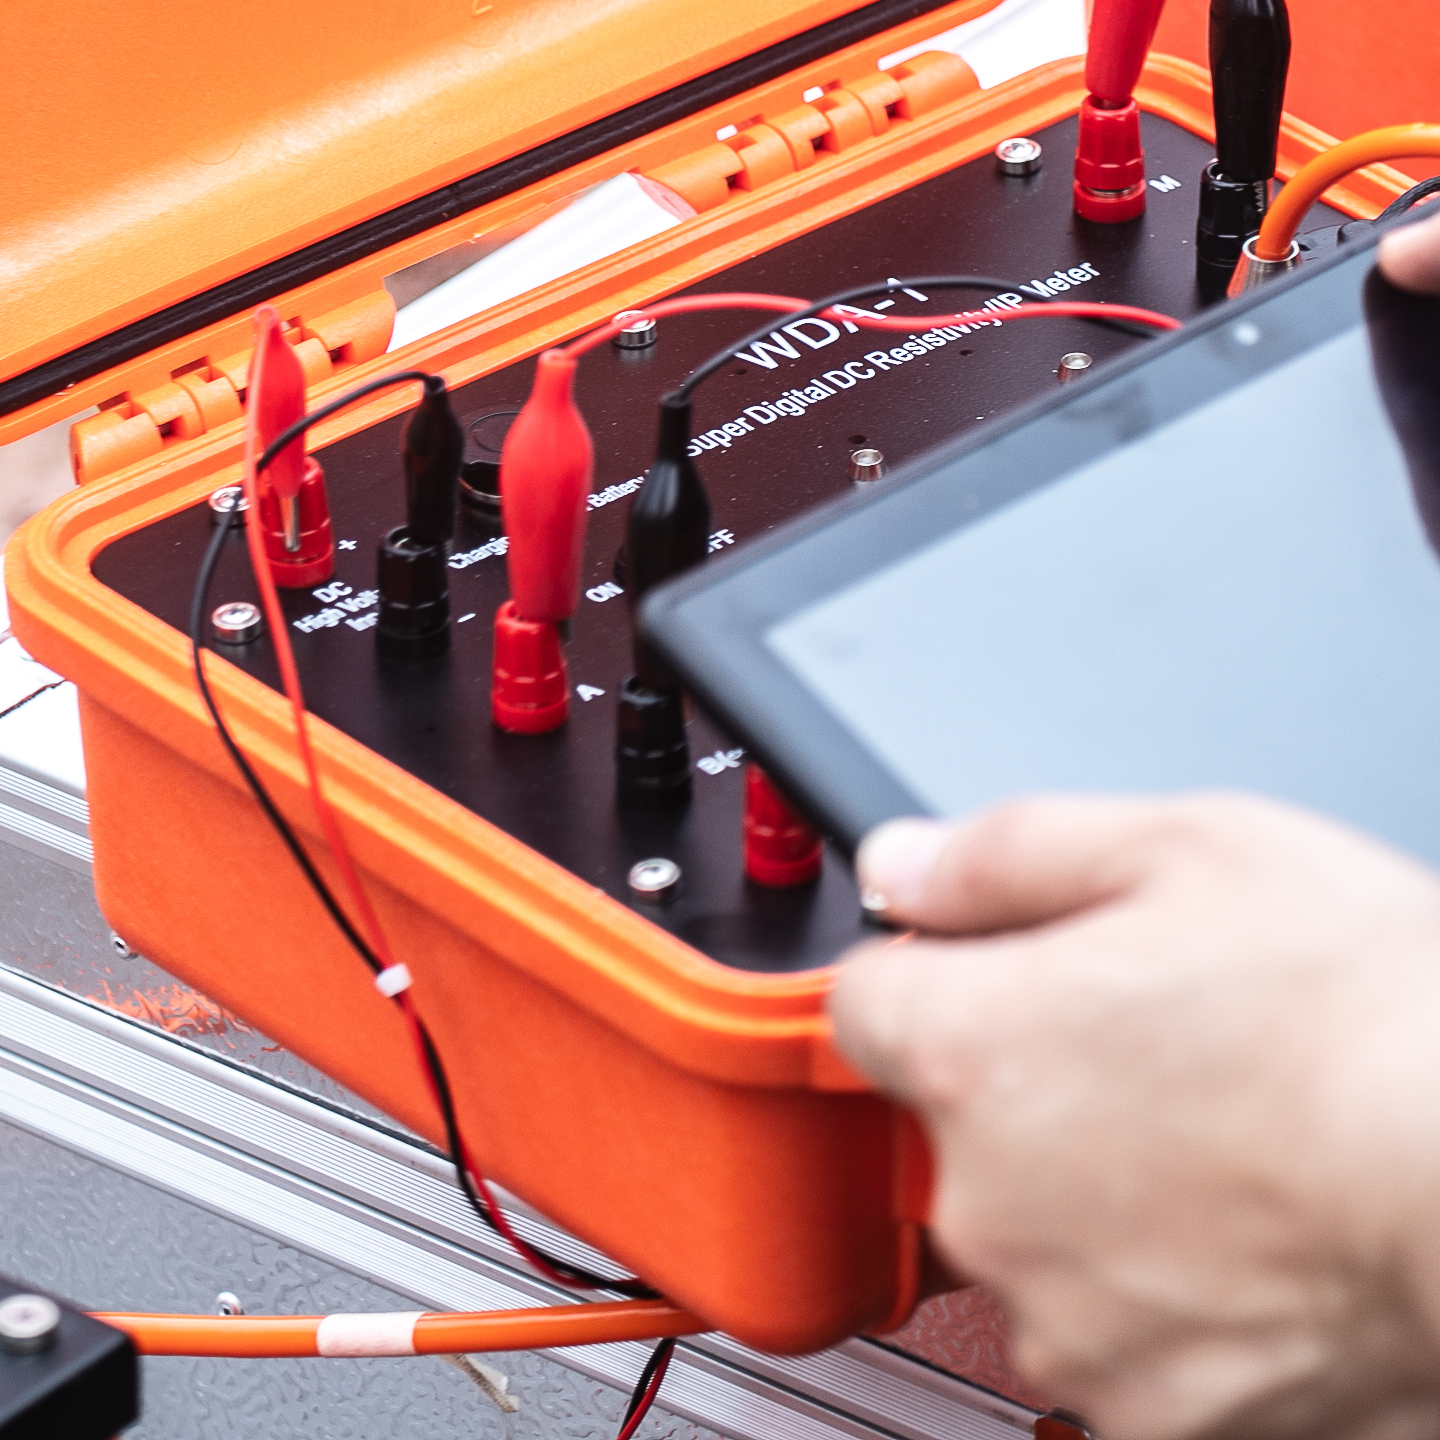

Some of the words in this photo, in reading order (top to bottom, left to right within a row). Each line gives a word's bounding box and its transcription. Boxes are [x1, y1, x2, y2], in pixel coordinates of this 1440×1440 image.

[1148, 174, 1182, 193] M
[733, 276, 929, 371] WDA-1
[743, 378, 837, 426] Digital
[822, 360, 877, 391] DC
[1019, 261, 1101, 303] Meter
[586, 469, 650, 508] Batter
[312, 581, 353, 603] DC
[585, 581, 624, 603] ON
[575, 684, 606, 702] A
